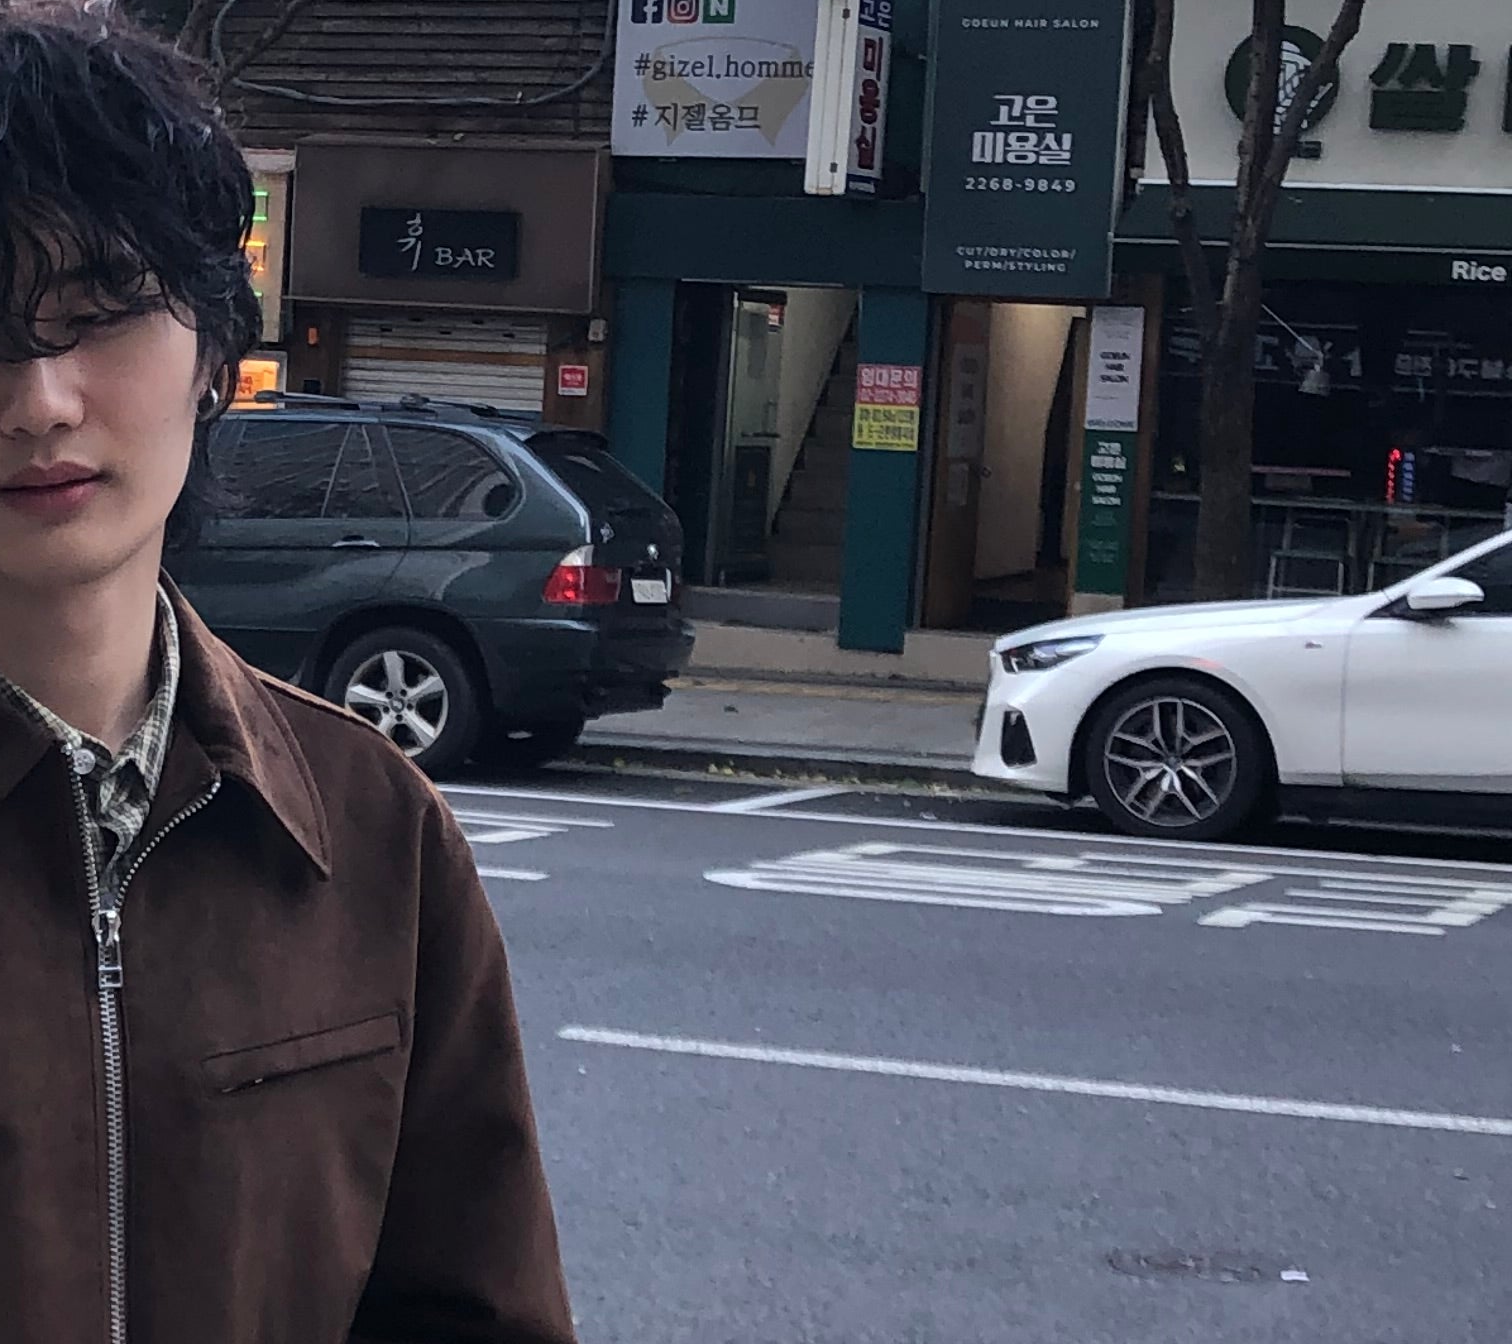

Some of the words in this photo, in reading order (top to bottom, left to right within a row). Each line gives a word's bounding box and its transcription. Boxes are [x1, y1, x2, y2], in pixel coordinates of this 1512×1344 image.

[1014, 18, 1048, 29] HAIR
[1053, 18, 1099, 30] SALON
[856, 36, 884, 170] 미용실
[989, 94, 1059, 128] 고은
[655, 103, 761, 131] 지젤옴므
[971, 131, 1073, 165] 미용실
[965, 176, 1076, 193] 2268-9849
[434, 247, 495, 268] BAR
[1451, 260, 1508, 283] Rice
[861, 368, 918, 388] 임대문의
